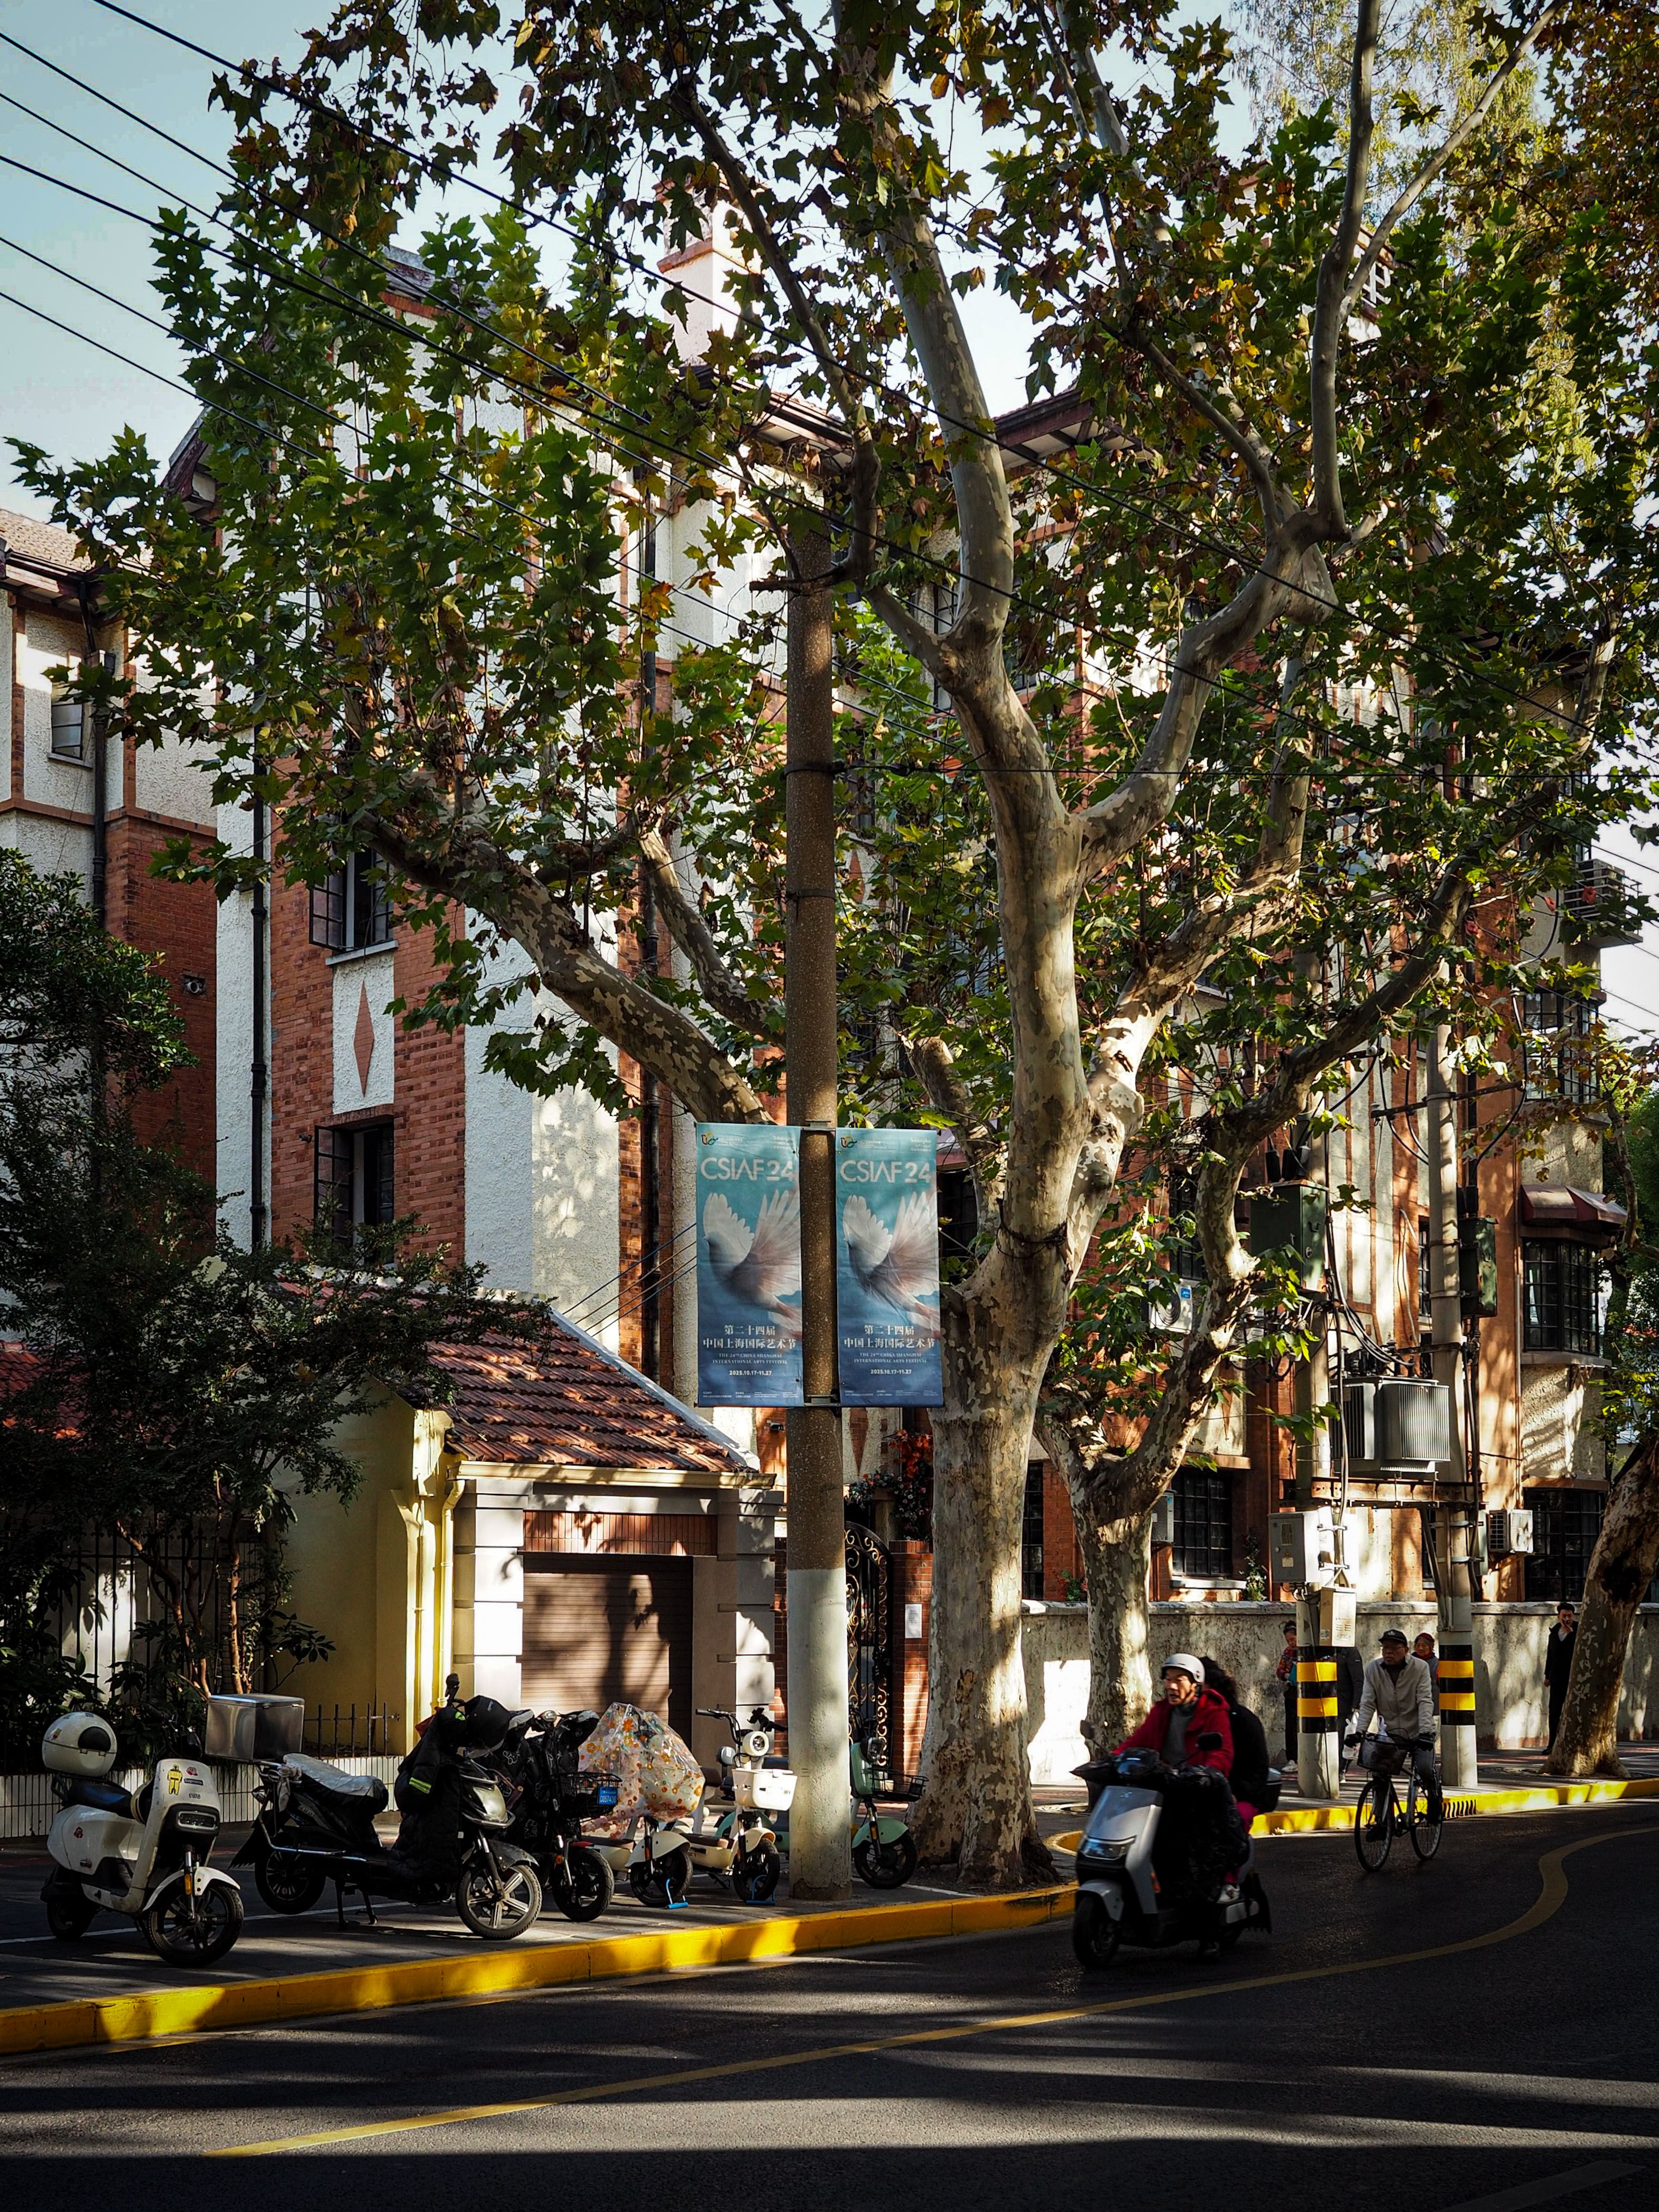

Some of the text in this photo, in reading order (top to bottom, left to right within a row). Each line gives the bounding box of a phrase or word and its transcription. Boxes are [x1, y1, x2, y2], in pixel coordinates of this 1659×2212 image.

[701, 1157, 793, 1182] CSIAF 24
[840, 1160, 931, 1183] CSIAF 24
[724, 1325, 775, 1336] 第二十四届
[864, 1325, 914, 1335] 第二十四届
[703, 1337, 796, 1350] 中国上海国际艺术节
[844, 1337, 935, 1349] 中国上海国际艺术节
